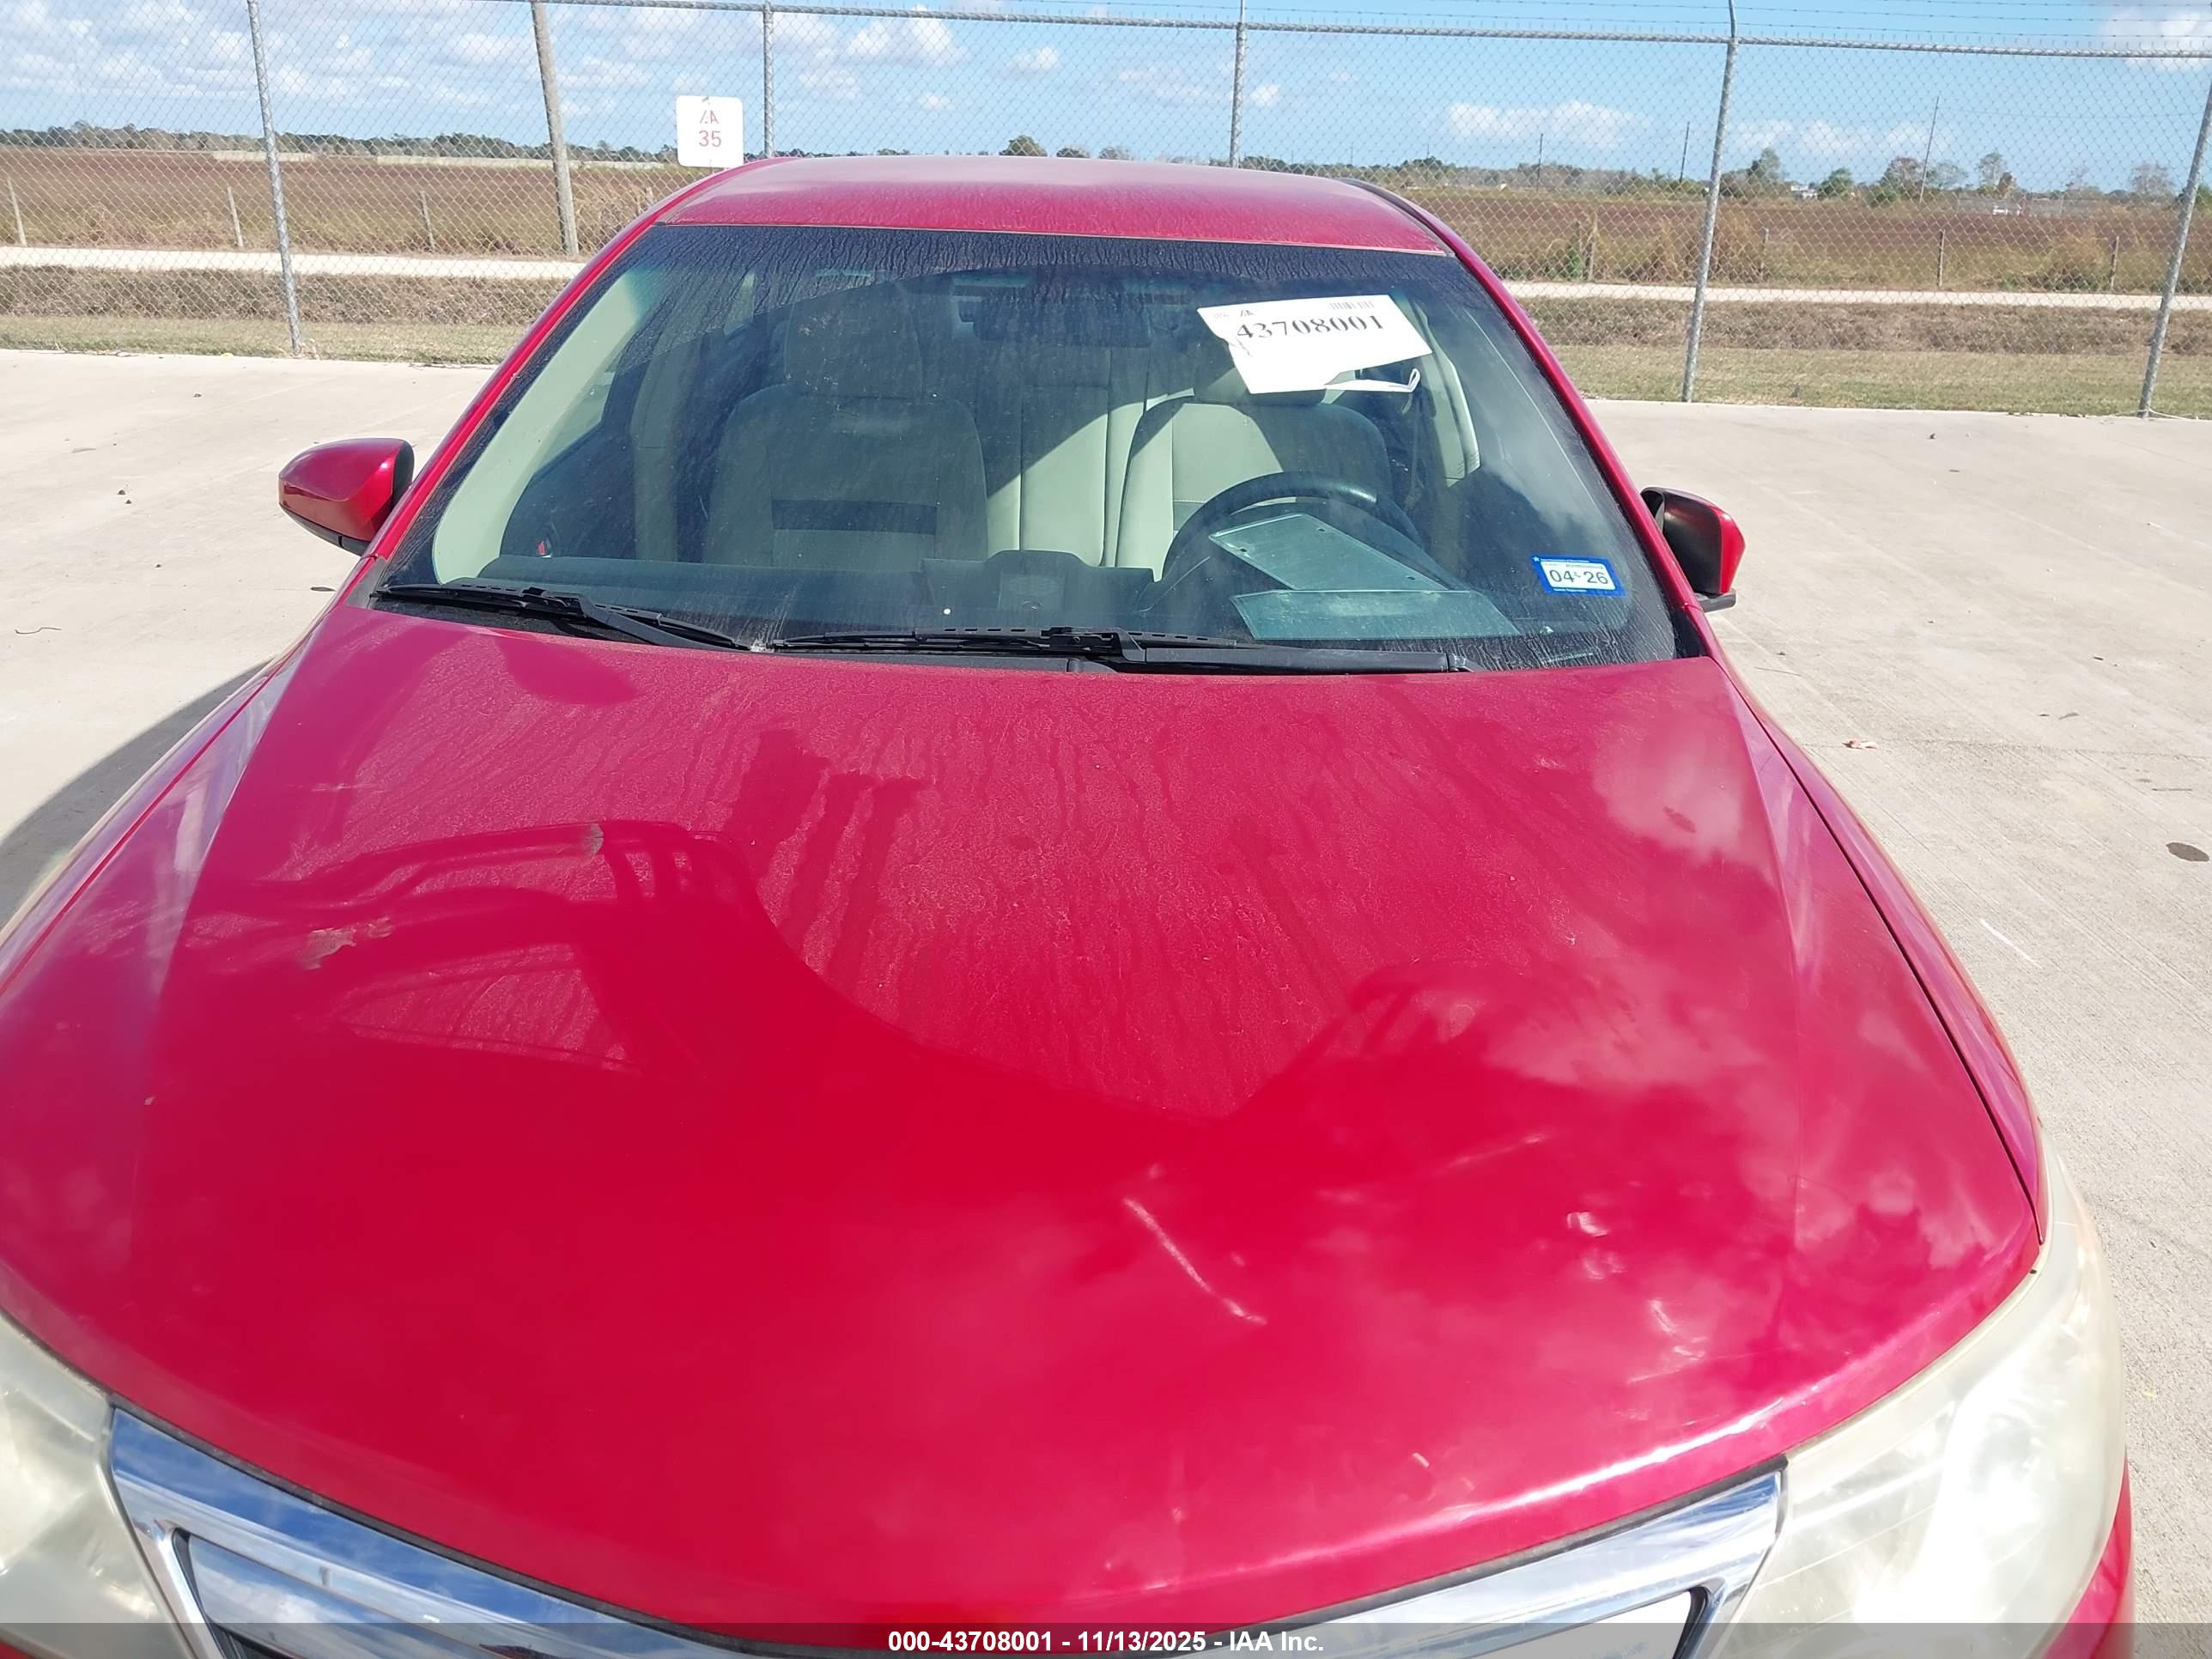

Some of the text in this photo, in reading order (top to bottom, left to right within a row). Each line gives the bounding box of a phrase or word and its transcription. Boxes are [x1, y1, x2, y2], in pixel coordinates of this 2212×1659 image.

[698, 130, 722, 148] 35
[1237, 314, 1383, 339] 43708001
[1549, 569, 1608, 585] 04 26
